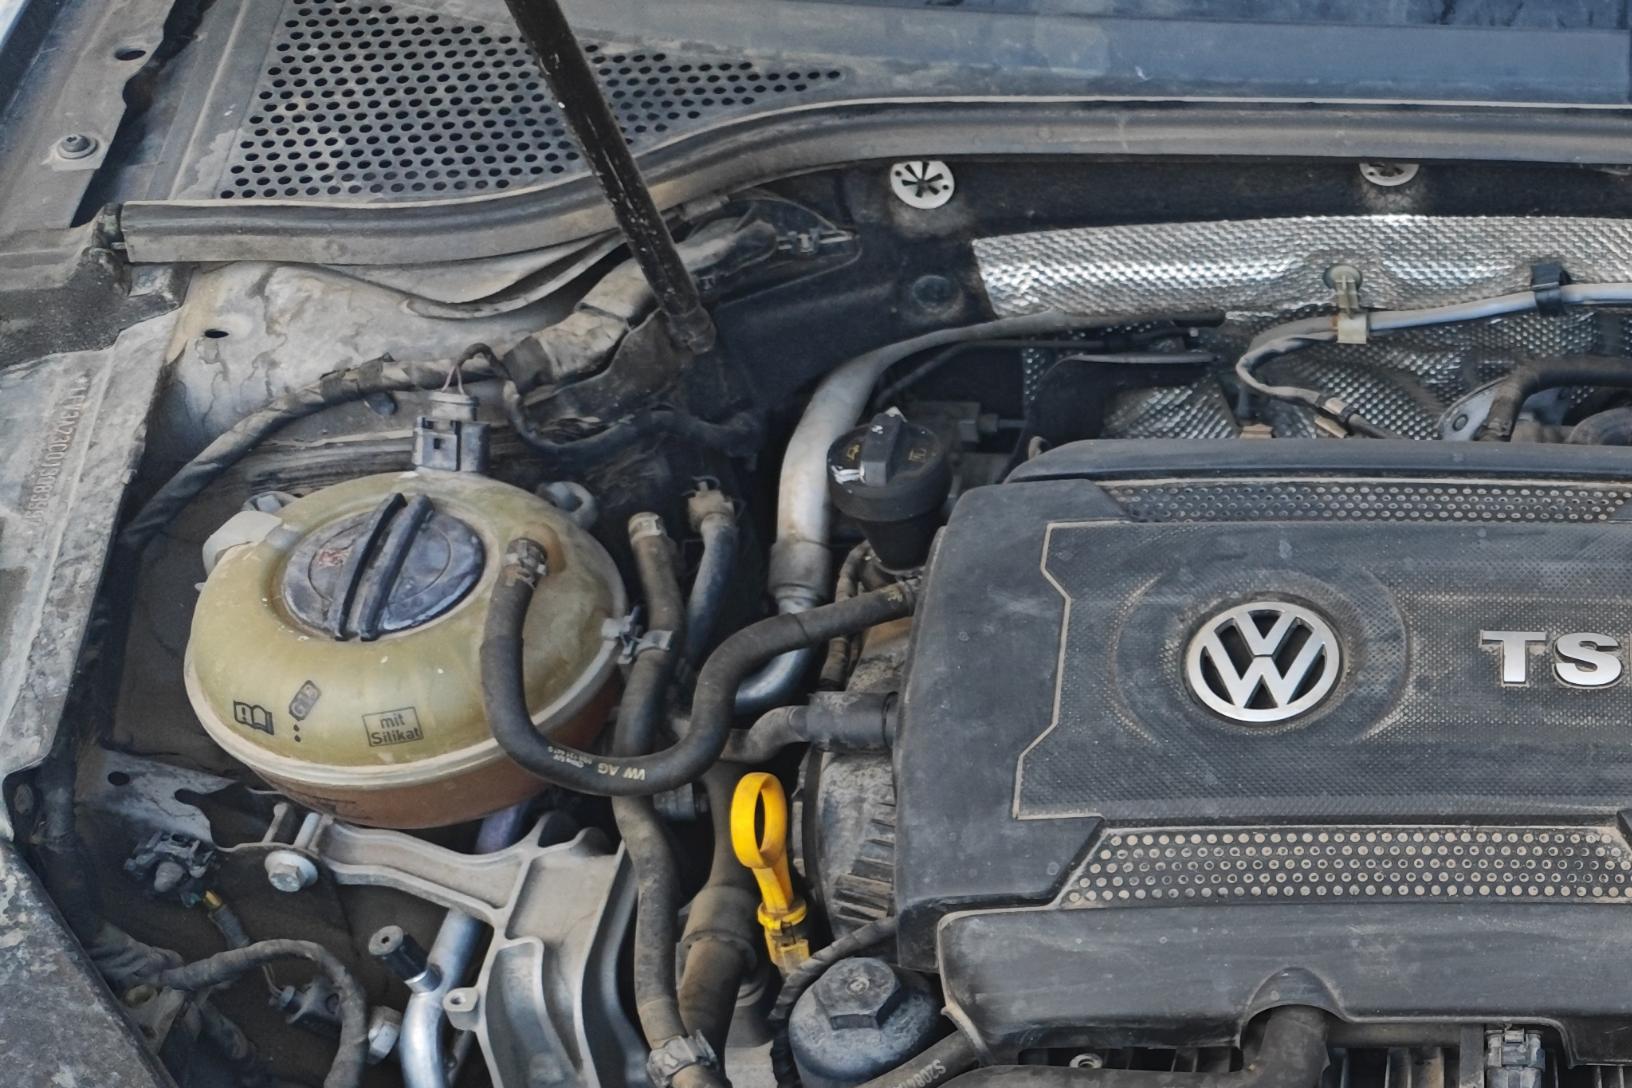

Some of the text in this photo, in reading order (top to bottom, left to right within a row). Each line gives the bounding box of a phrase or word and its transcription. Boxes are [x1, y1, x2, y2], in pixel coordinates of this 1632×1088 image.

[1186, 600, 1343, 723] VW
[380, 712, 405, 729] mit
[371, 727, 421, 745] Silikat
[597, 762, 646, 781] VW AG
